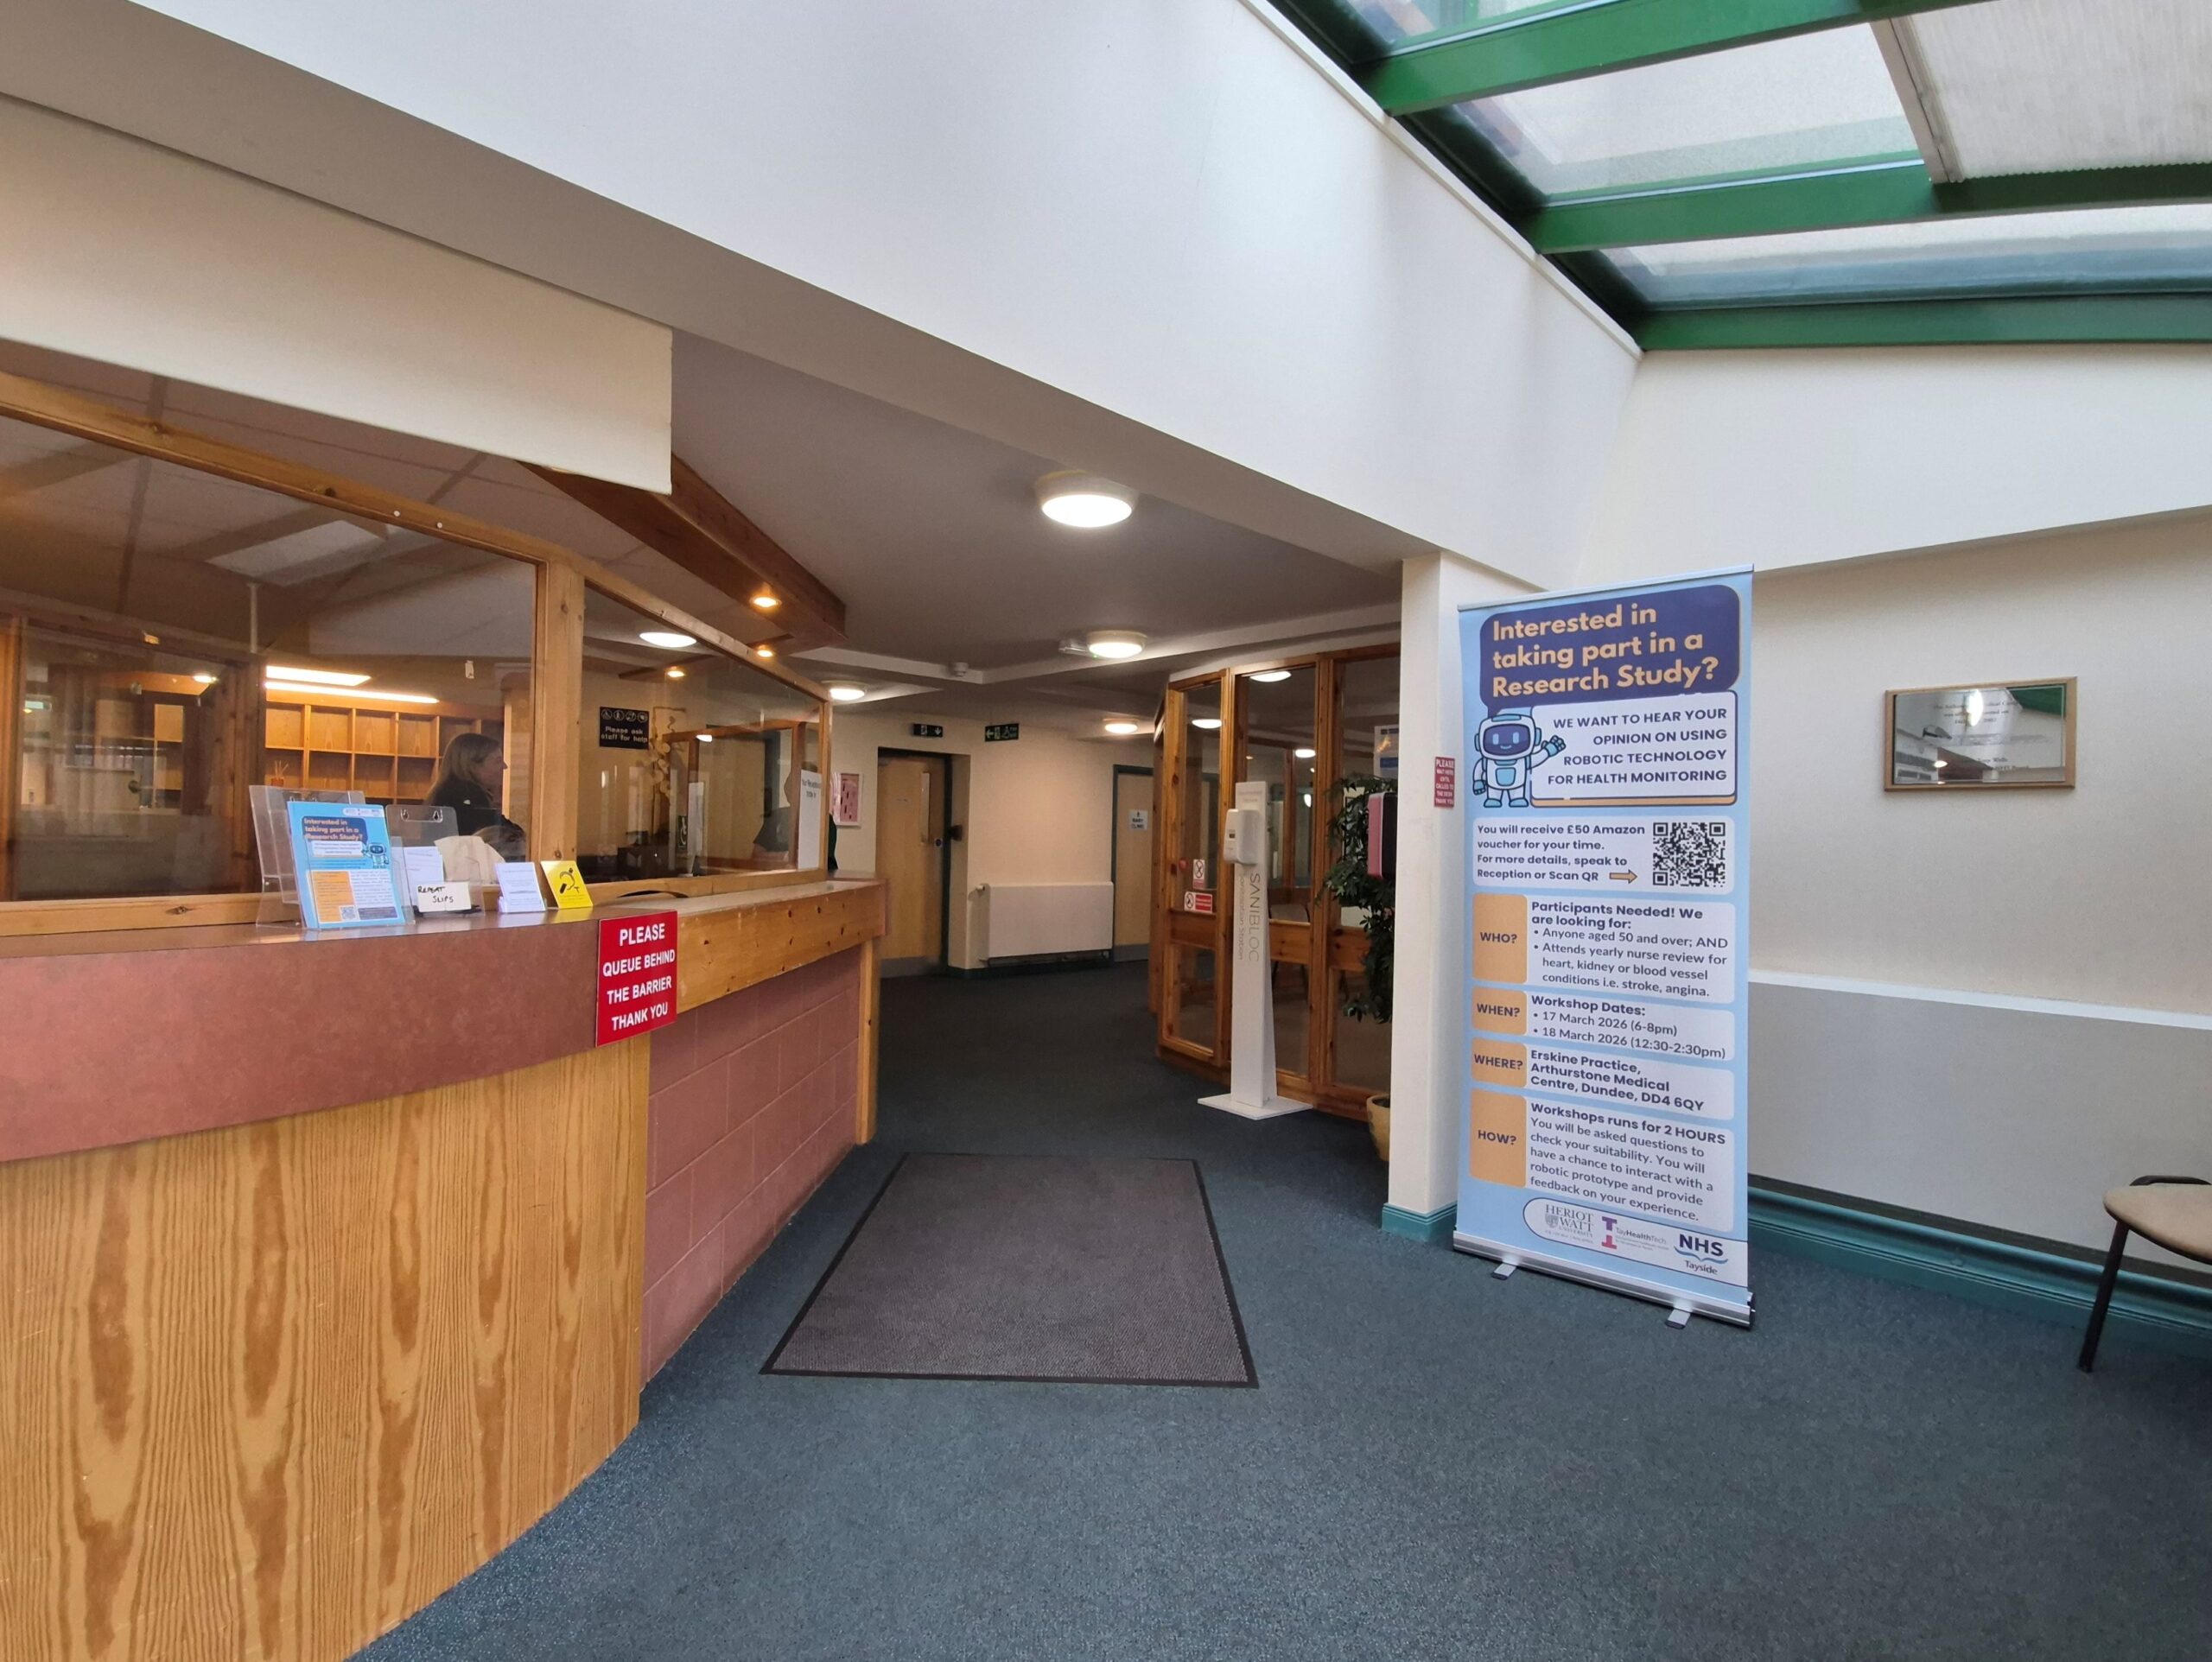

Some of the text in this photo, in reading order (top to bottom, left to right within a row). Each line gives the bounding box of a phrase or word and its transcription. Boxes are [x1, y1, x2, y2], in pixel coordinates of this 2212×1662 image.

[1493, 603, 1656, 641] Interested in
[1492, 631, 1703, 669] taking part in a
[1493, 656, 1719, 698] Research Study?
[1554, 708, 1727, 729] WE WANT TO HEAR YOUR
[1593, 729, 1727, 745] OPINION ON USING
[1564, 750, 1727, 765] ROBOTIC TECHNOLOGY
[1548, 770, 1727, 785] FOR HEALTH MONITORING
[1478, 825, 1645, 834] You will receive £50 Amazon
[1478, 840, 1521, 848] voucher
[1524, 841, 1540, 849] for
[1542, 842, 1570, 851] your
[1478, 854, 1493, 863] For
[1528, 856, 1571, 866] details,
[1574, 857, 1611, 867] speak
[1478, 869, 1531, 880] Reception
[1549, 871, 1579, 880] Scan
[1582, 872, 1599, 881] QR
[1249, 872, 1261, 961] SANIBLOC
[1531, 901, 1702, 919] Participants Needed! We
[1531, 915, 1631, 930] are looking for:
[620, 923, 665, 947] PLEASE
[1480, 932, 1517, 943] WHO?
[1542, 928, 1728, 948] Anyone aged 50 and over; AND
[603, 949, 675, 976] QUEUE BEHIND
[1542, 943, 1727, 965] Attends yearly nurse review for
[1542, 958, 1707, 980] heart, kidney or blood vessel
[607, 975, 672, 1005] THE BARRIER
[1542, 973, 1709, 997] conditions i.e. stroke, angina.
[612, 1002, 668, 1031] THANK YOU
[1477, 1004, 1521, 1017] WHEN?
[1531, 995, 1645, 1016] Workshop Dates:
[1543, 1011, 1677, 1037] 17 March 2026 (6-8pm)
[1543, 1027, 1726, 1060] 18 March 2026 (12:30-2:30pm)
[1474, 1054, 1523, 1070] WHERE?
[1531, 1050, 1641, 1075] Erskine Practice,
[1530, 1063, 1669, 1092] Arthurstone Medical
[1530, 1076, 1704, 1112] Centre, Dundee, DD4 6QY
[1530, 1102, 1726, 1145] Workshops runs for 2 HOURS
[1478, 1130, 1516, 1145] HOW?
[1530, 1117, 1704, 1158] You will be asked questions to
[1530, 1132, 1705, 1174] check your suitability. You will
[1530, 1147, 1713, 1192] have a chance to interact with a
[1530, 1162, 1703, 1206] robotic prototype and provide
[1530, 1177, 1699, 1221] feedback on your experience.
[1546, 1204, 1593, 1222] HERIOT
[1559, 1216, 1593, 1232] WATT
[1680, 1234, 1724, 1257] NHS
[1685, 1260, 1718, 1275] Tayside
